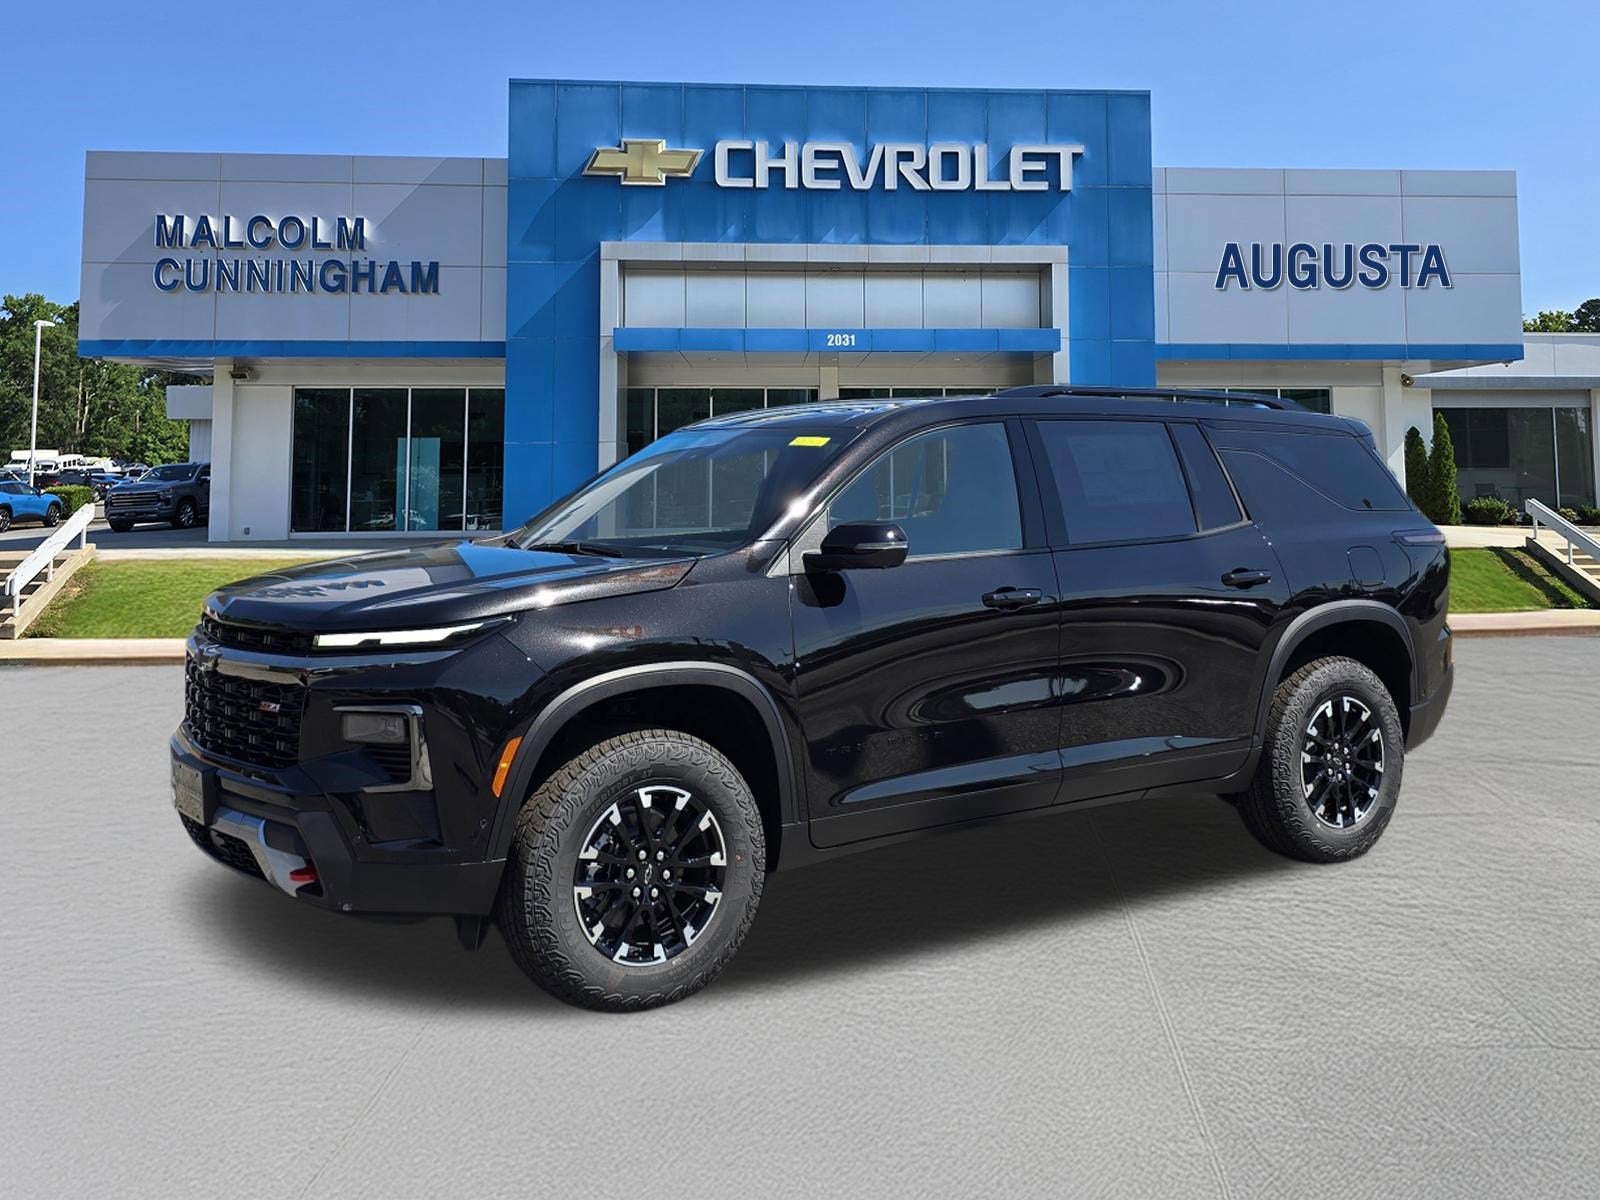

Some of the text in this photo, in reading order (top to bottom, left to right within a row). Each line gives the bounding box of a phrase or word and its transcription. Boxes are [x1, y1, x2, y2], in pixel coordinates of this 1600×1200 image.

[714, 139, 1085, 192] CHEVROLET
[154, 214, 367, 250] MALCOLM
[152, 257, 440, 294] CUNNINGHAM
[1214, 241, 1452, 290] AUGUSTA
[826, 333, 856, 347] 2031
